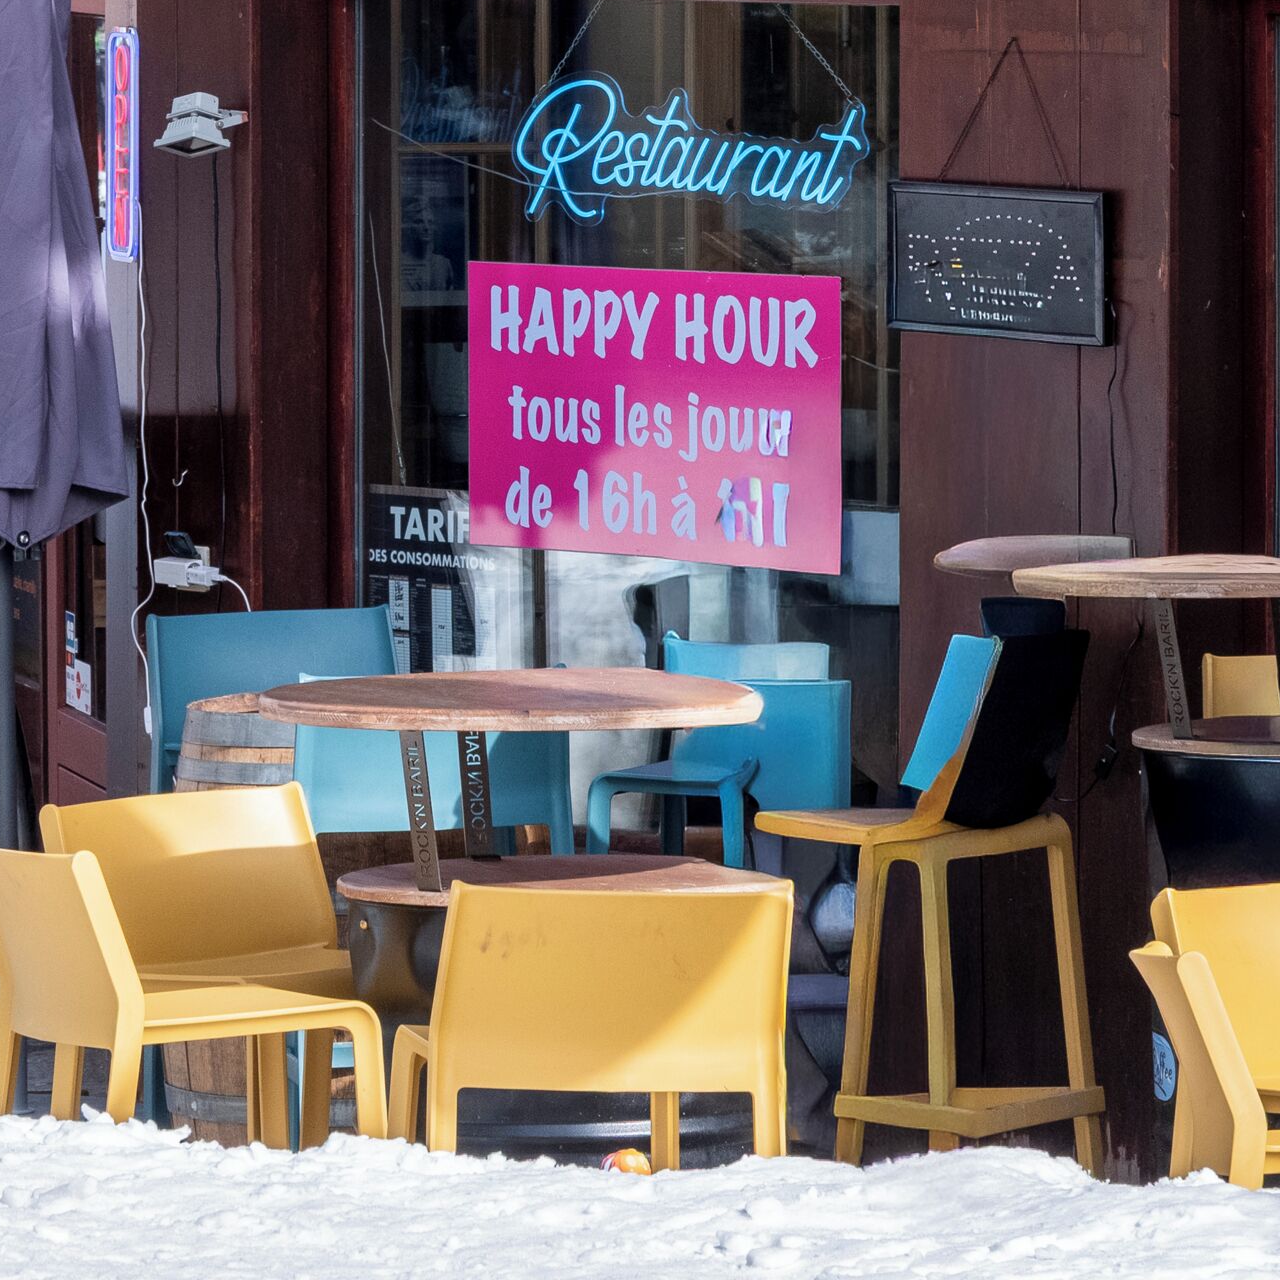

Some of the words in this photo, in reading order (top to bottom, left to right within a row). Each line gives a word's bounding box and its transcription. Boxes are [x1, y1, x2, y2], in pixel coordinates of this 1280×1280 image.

[516, 79, 862, 219] Restaurant
[490, 285, 660, 361] HAPPY
[675, 293, 819, 368] HOUR
[508, 384, 602, 445] tous
[615, 384, 672, 448] les
[505, 466, 554, 529] de
[573, 468, 658, 536] 16h
[671, 476, 698, 541] à
[369, 549, 387, 563] DES
[390, 550, 496, 571] CONSOMMATIONS
[1158, 608, 1176, 658] BARIL
[1166, 663, 1185, 727] ROCK'N
[406, 740, 424, 797] BARIL
[413, 803, 433, 878] ROCK'N
